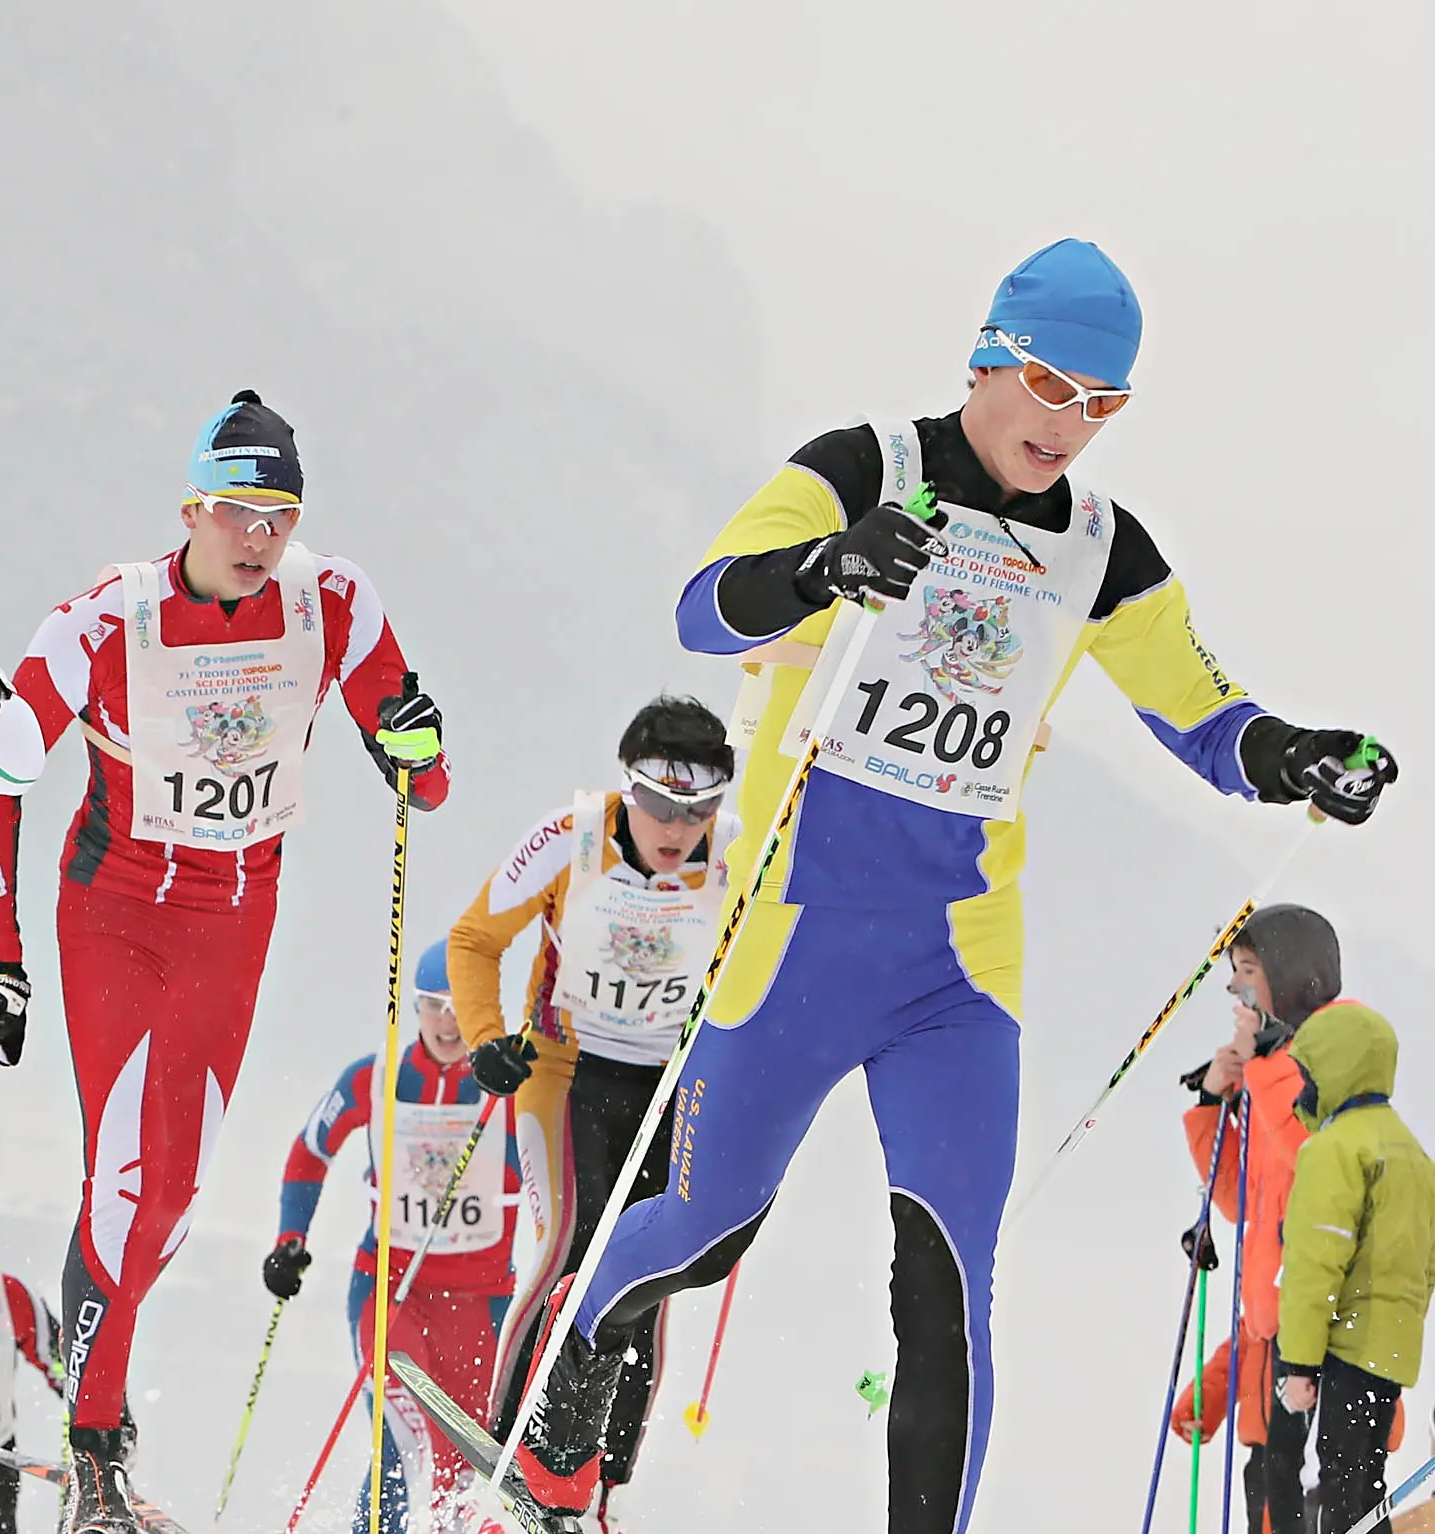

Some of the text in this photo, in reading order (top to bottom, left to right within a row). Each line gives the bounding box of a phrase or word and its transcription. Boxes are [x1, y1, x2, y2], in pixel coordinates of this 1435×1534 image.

[889, 434, 907, 492] TRENTINO
[941, 555, 1027, 585] SCI DI FONDO
[948, 542, 1001, 565] TROFEO
[925, 562, 1063, 605] TELLO DI FIEMME (TN)
[165, 687, 219, 698] CASTELLO
[221, 686, 234, 695] DI
[236, 682, 274, 693] FIEMME
[195, 675, 269, 688] SCI DI FONDO
[198, 669, 240, 679] TROFEO
[855, 678, 1011, 769] 1208
[164, 761, 279, 821] 1207
[864, 755, 935, 791] BAILO
[192, 826, 244, 841] BAILO
[506, 813, 574, 886] LIVIGNO
[585, 967, 690, 1015] 1175
[670, 1086, 689, 1165] VARENA
[397, 1192, 482, 1228] 1176
[520, 1146, 545, 1243] LIVIGNO
